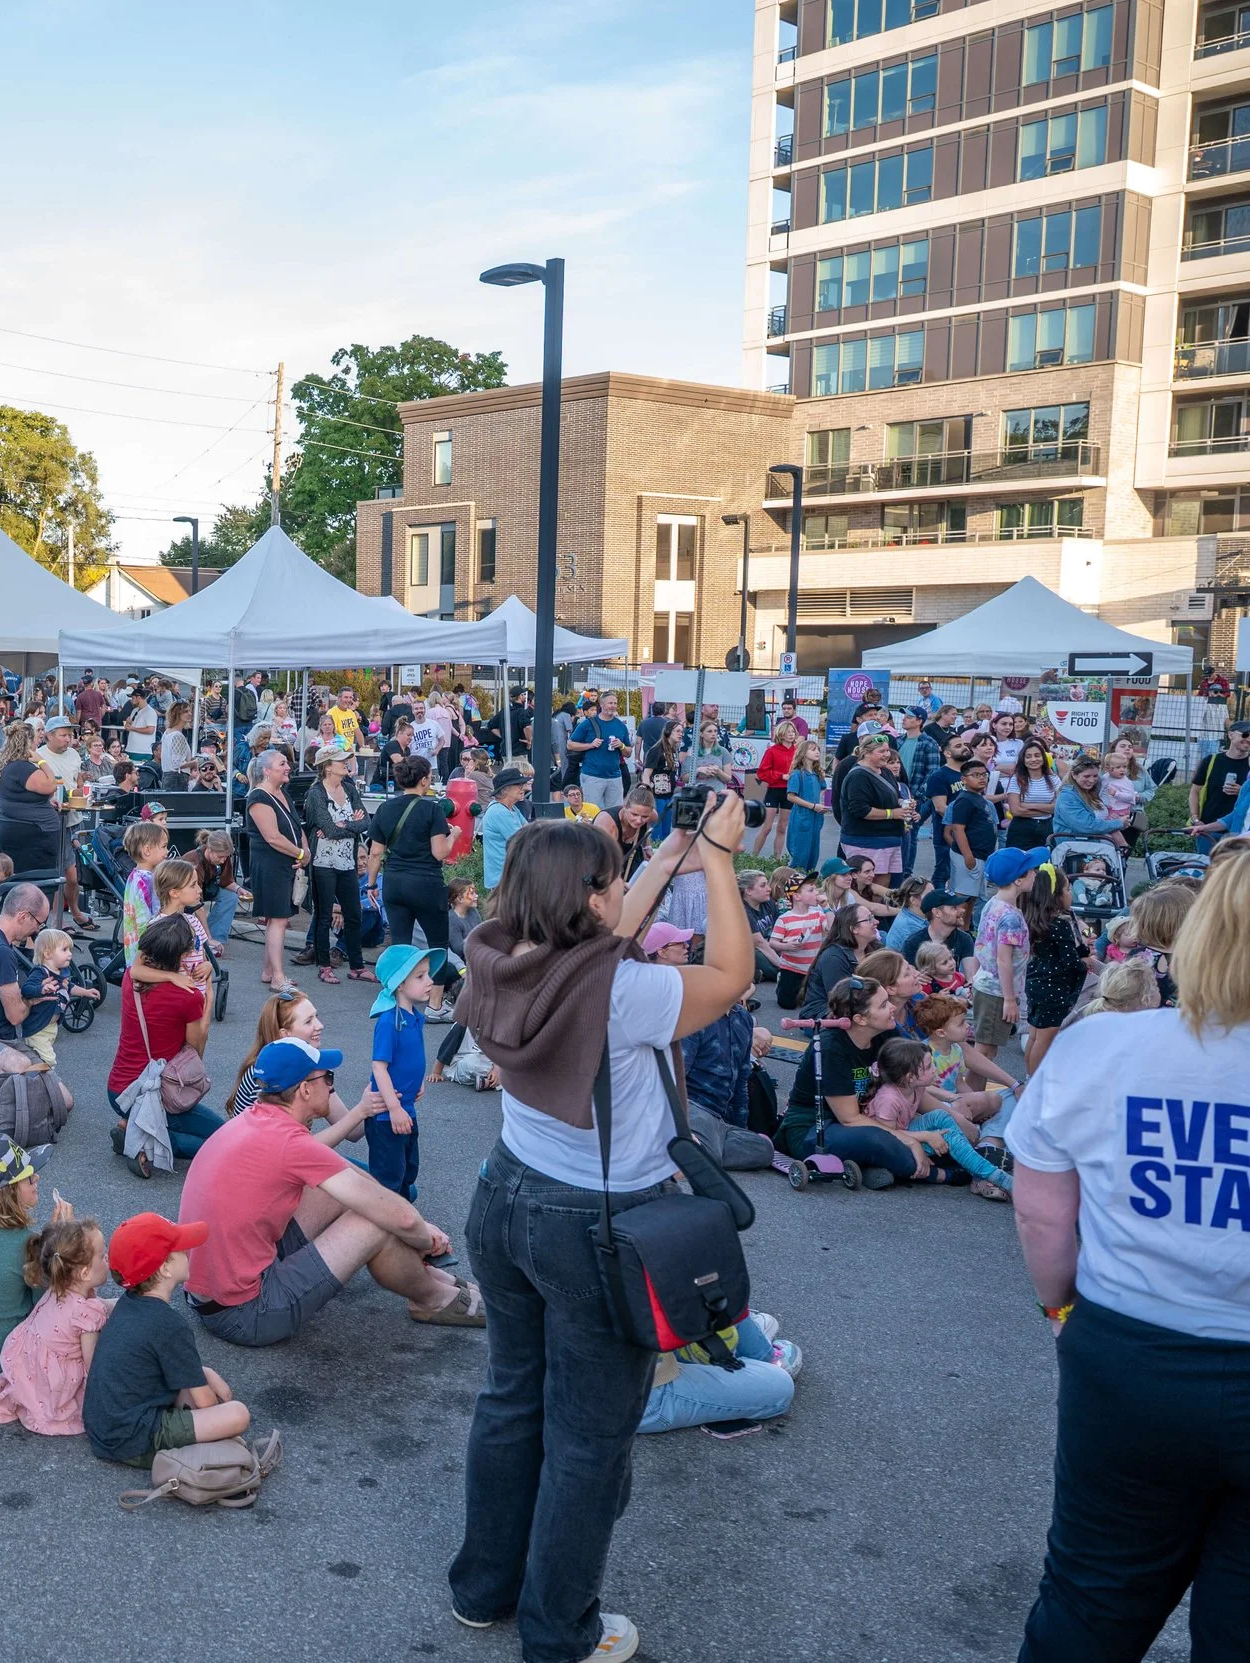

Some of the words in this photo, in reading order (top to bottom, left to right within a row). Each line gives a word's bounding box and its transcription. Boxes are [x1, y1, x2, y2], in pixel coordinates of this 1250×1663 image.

[850, 680, 868, 688] HOPE
[1070, 716, 1098, 727] FOOD
[414, 728, 433, 742] HOPE
